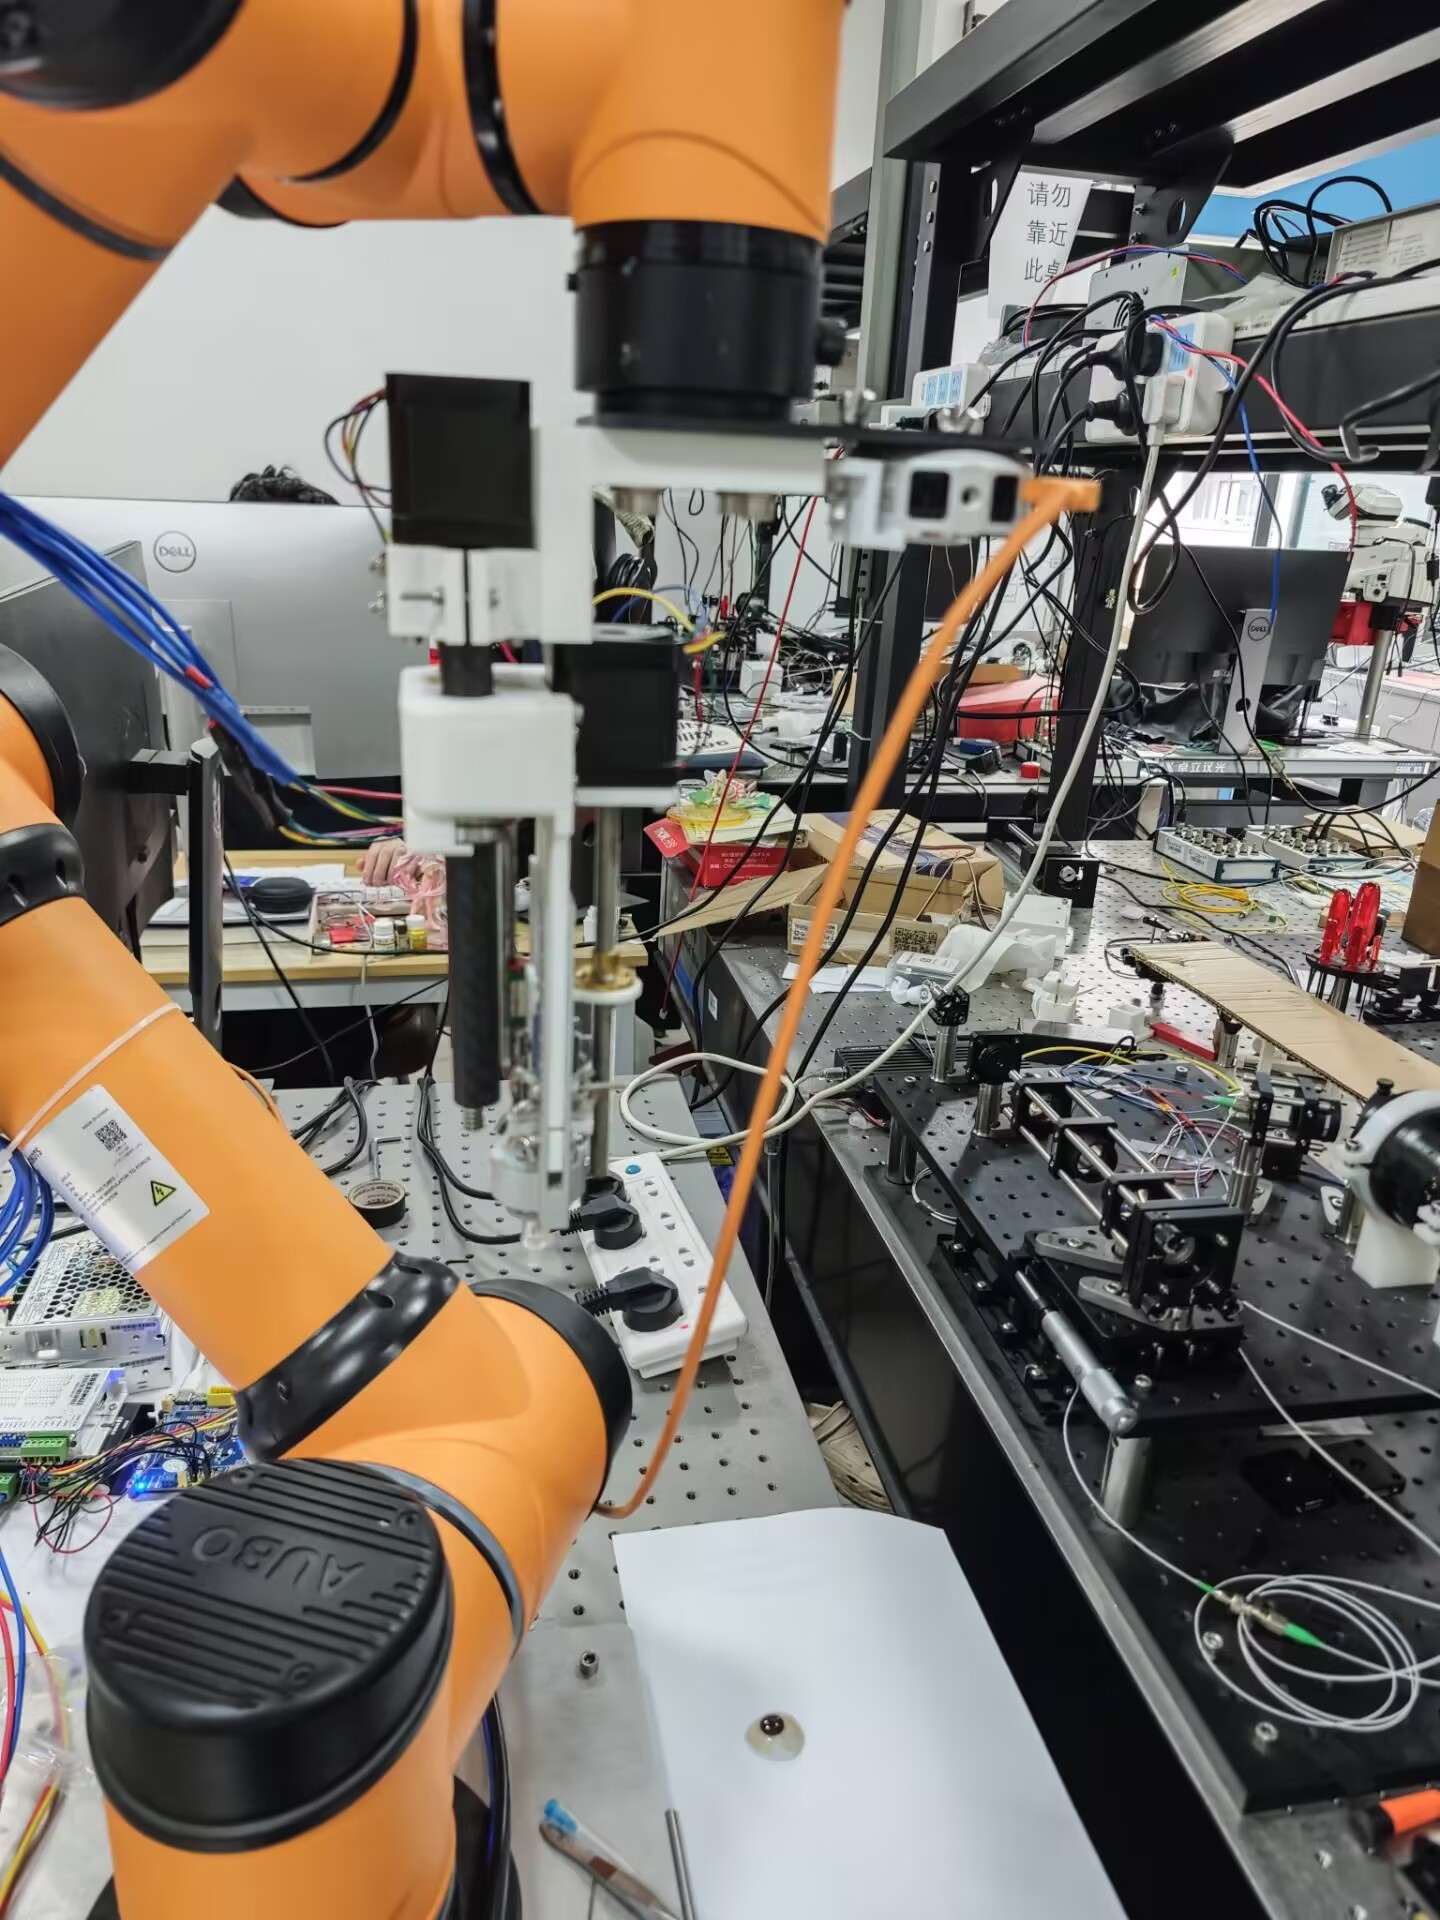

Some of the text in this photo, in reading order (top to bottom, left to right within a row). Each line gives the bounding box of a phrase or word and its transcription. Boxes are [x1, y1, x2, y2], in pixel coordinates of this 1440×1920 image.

[1027, 181, 1071, 208] 请勿
[1026, 219, 1069, 247] 靠近
[159, 546, 192, 557] DELL
[1177, 761, 1225, 772] 卓立汉光
[192, 1525, 366, 1597] AUBO
